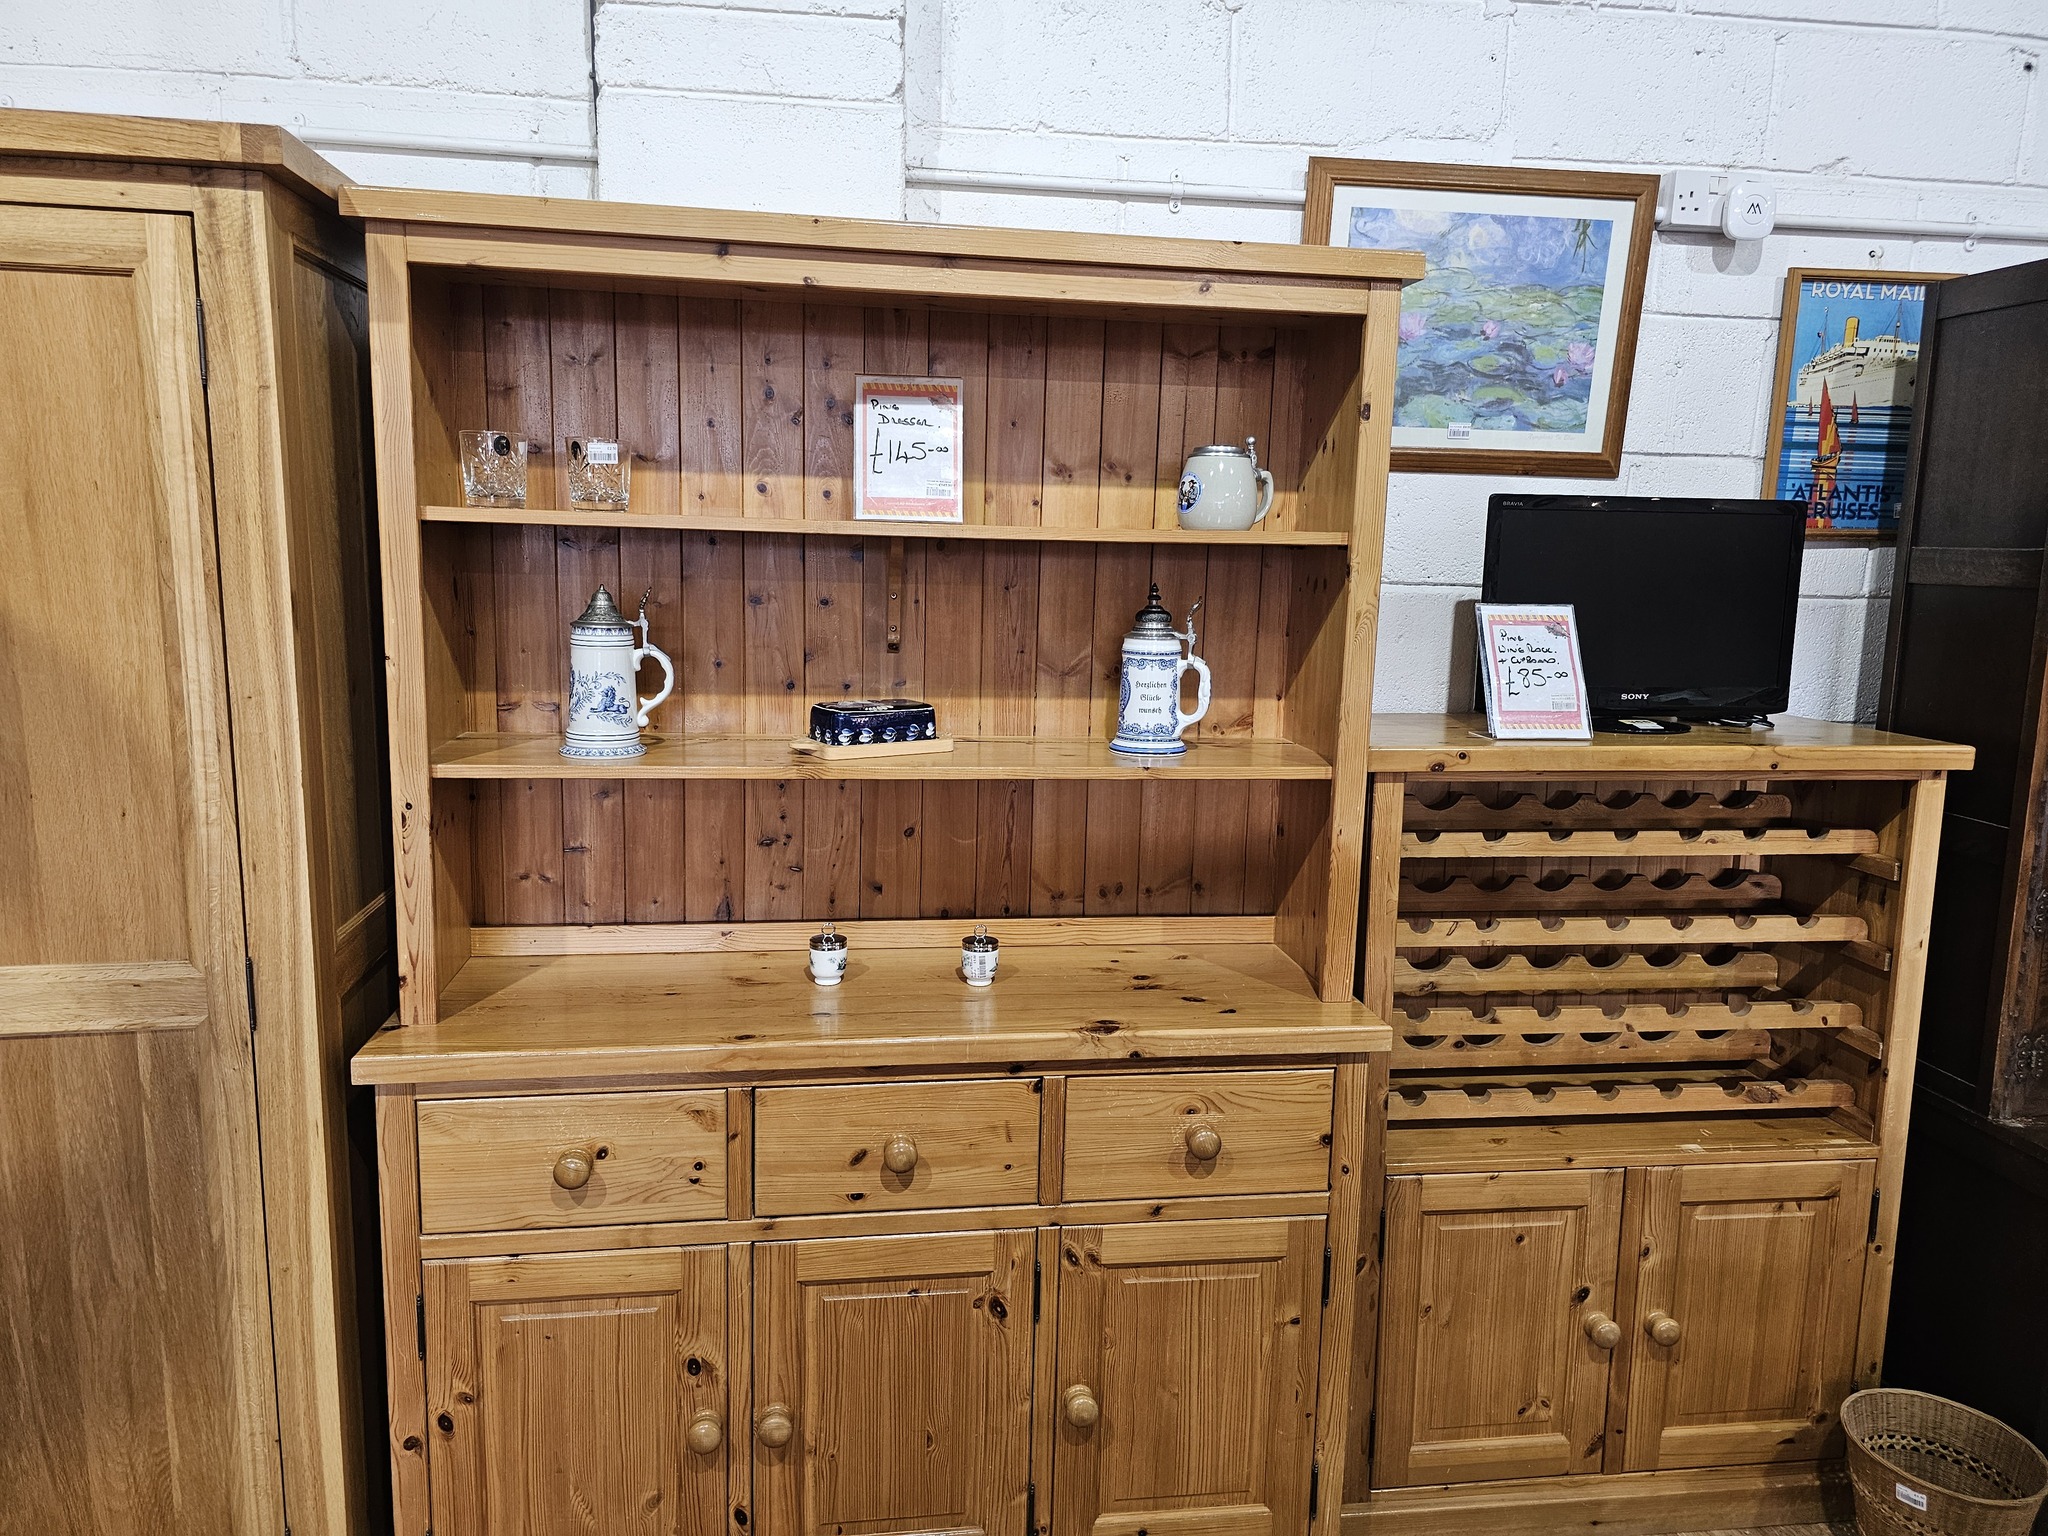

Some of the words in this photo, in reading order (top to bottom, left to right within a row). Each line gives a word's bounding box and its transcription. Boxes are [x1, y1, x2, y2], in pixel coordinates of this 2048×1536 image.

[1811, 281, 1875, 300] ROYAL
[1880, 284, 1926, 302] MAIL
[1620, 693, 1650, 701] SONY
